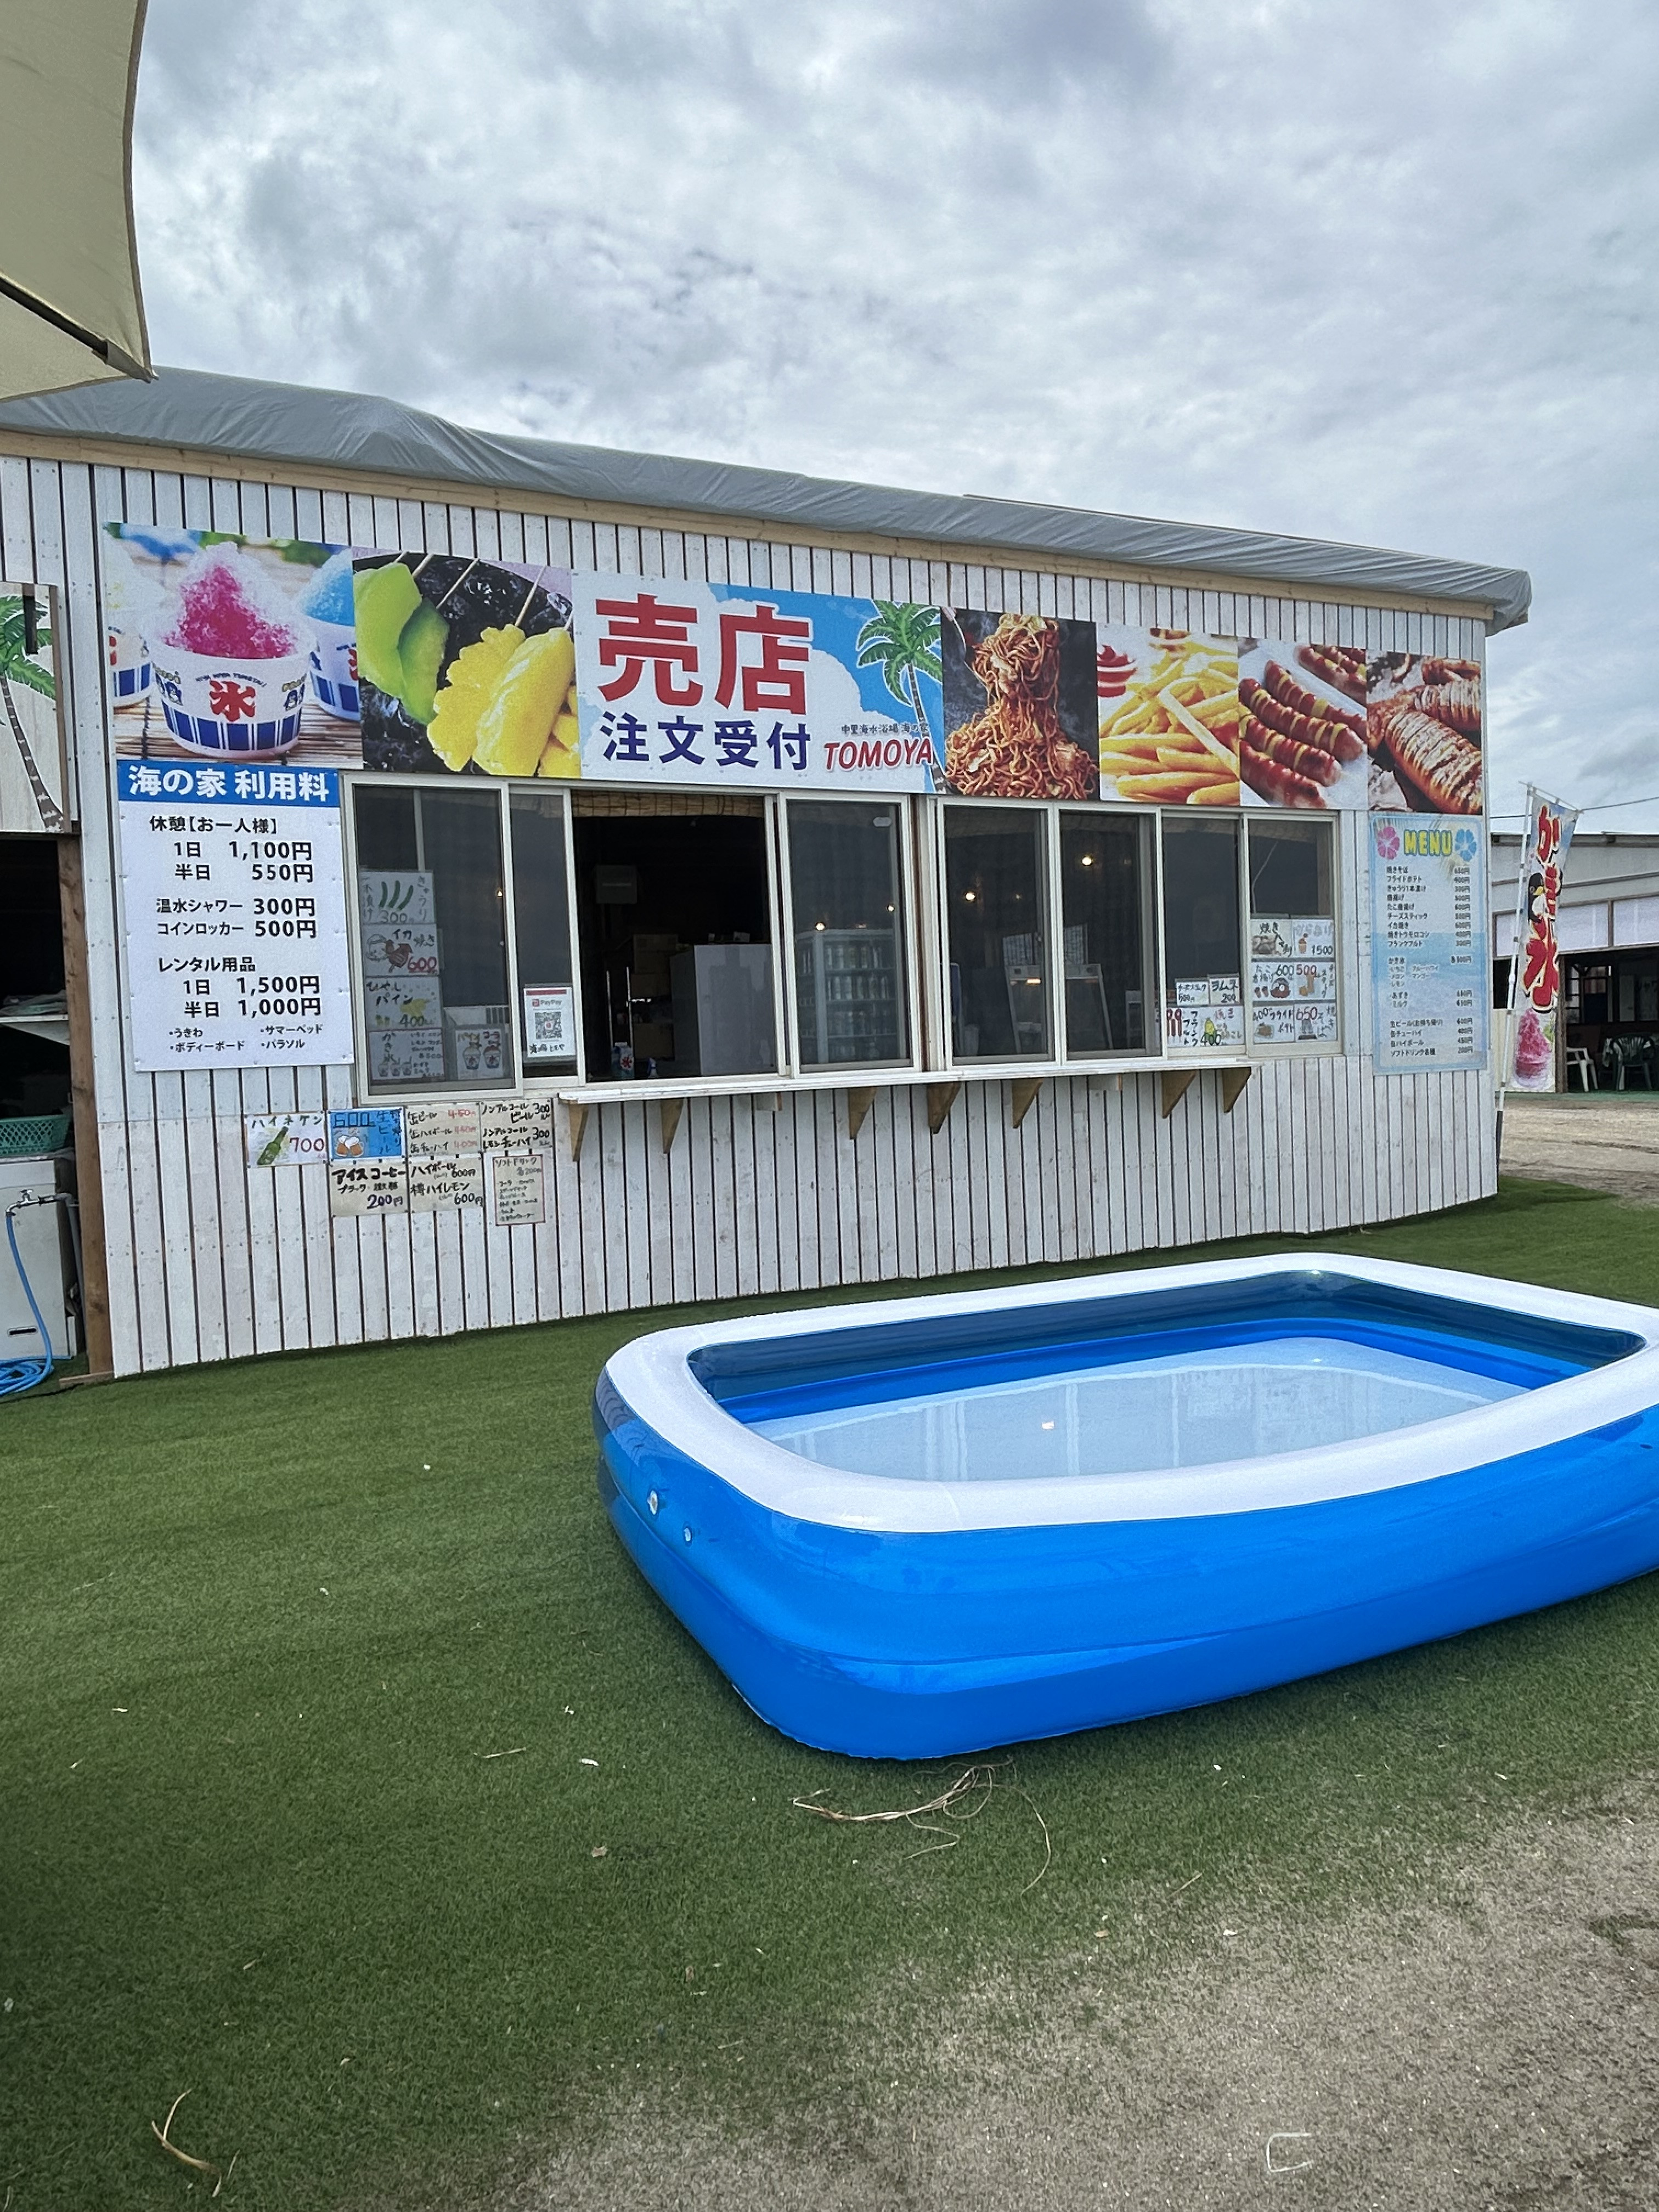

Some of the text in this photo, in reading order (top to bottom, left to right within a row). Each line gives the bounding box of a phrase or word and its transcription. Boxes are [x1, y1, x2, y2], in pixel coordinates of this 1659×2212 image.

[596, 593, 810, 715] 売店
[210, 678, 256, 722] 氷
[600, 711, 811, 769] 注文受付
[824, 738, 932, 770] TOMOYA
[128, 765, 329, 802] 海の家 利用料
[150, 815, 277, 834] 休憩【お一人様】
[174, 841, 313, 861] 1日 1,100円
[1404, 830, 1453, 856] MENU
[175, 864, 313, 883] 半日 550円
[156, 898, 315, 917] 温水シャワー 300円
[1523, 804, 1560, 1007] かき氷
[158, 920, 317, 939] コインロッカー 500円
[159, 957, 256, 973] レンタル用品
[183, 975, 320, 996] 1日 1,500円
[184, 998, 321, 1018] 半日 1,000円
[1296, 1007, 1317, 1020] 650
[482, 1103, 529, 1115] ノンアルコール
[511, 1111, 534, 1124] ビール
[251, 1115, 322, 1128] ハイネケン
[335, 1112, 370, 1126] 600
[377, 1111, 391, 1154] 生ビール
[483, 1126, 528, 1137] ノンアルコール
[290, 1137, 325, 1152] 700
[331, 1167, 406, 1184] アイスコーヒー
[411, 1161, 457, 1178] ハイボール
[452, 1169, 476, 1178] 600円
[367, 1194, 404, 1209] 200円
[454, 1192, 483, 1207] 600円
